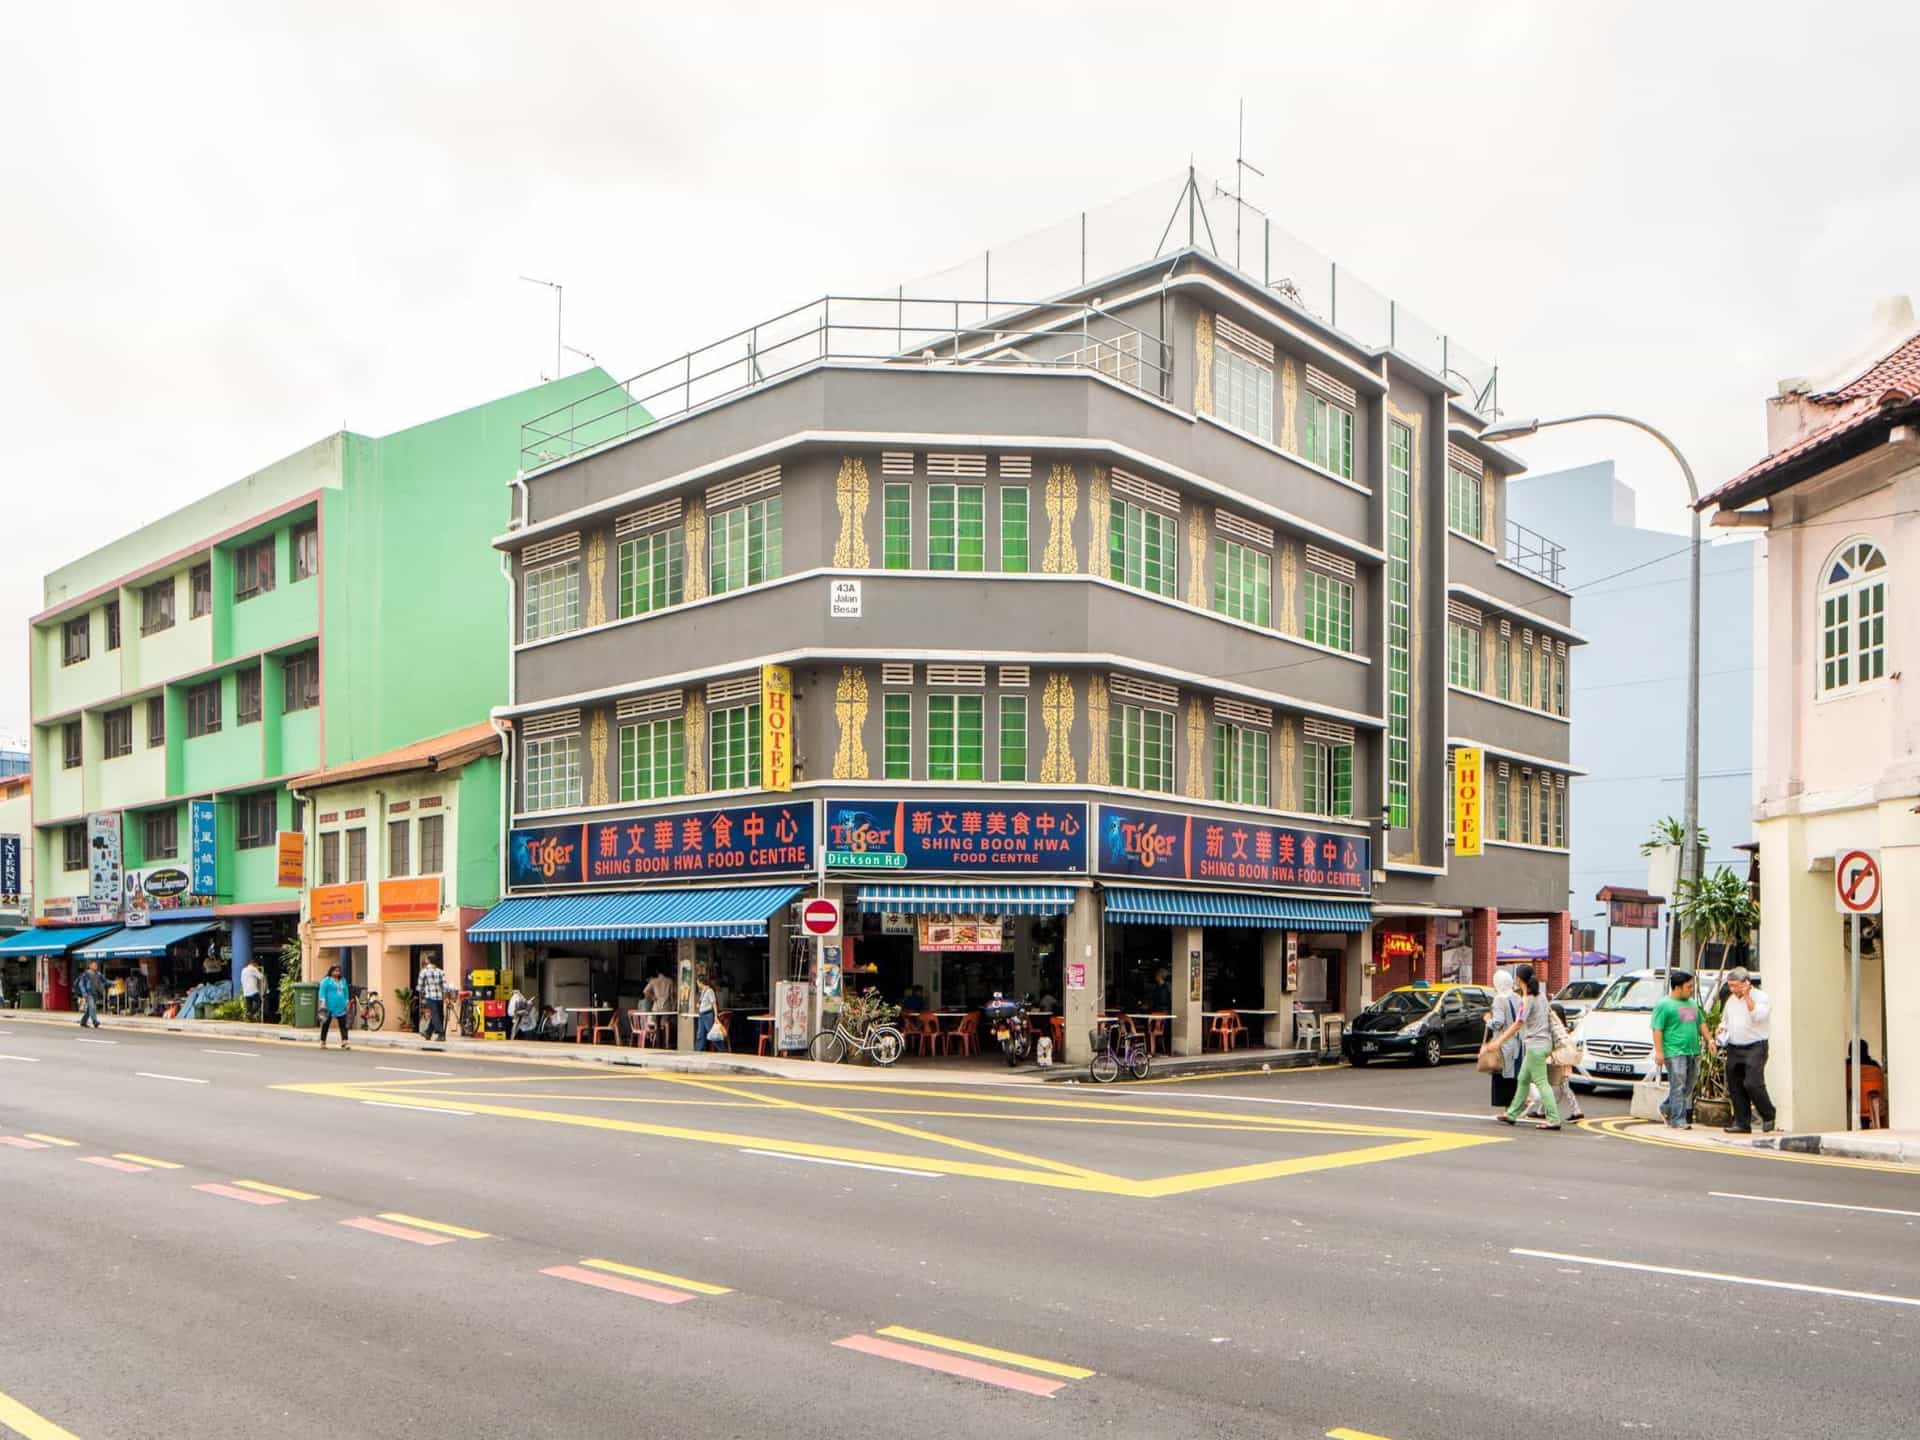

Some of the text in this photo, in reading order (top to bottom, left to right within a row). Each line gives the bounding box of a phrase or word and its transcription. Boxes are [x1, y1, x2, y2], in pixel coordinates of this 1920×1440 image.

[834, 594, 858, 603] Jalan
[836, 584, 855, 592] 43A
[833, 605, 858, 614] Besar
[768, 691, 785, 787] HOTEL
[1460, 769, 1476, 848] HOTEL
[599, 807, 799, 858] 新文華美食中心
[831, 822, 891, 852] Tiger
[911, 810, 1081, 836] 新文華美食中心
[527, 835, 574, 876] Tiger
[921, 838, 1071, 850] SHING BOON HWA
[1122, 821, 1176, 868] Tiger
[1206, 825, 1359, 870] 新文華美食中心
[5, 838, 15, 893] INTERNET
[594, 846, 807, 876] SHING BOON HWA FOOD CENTRE
[828, 852, 901, 866] Dickson Rd
[953, 853, 1039, 864] FOOD CENTRE
[1200, 860, 1362, 887] SHING BOON HWA FOOD CENTRE
[2, 894, 19, 904] 24
